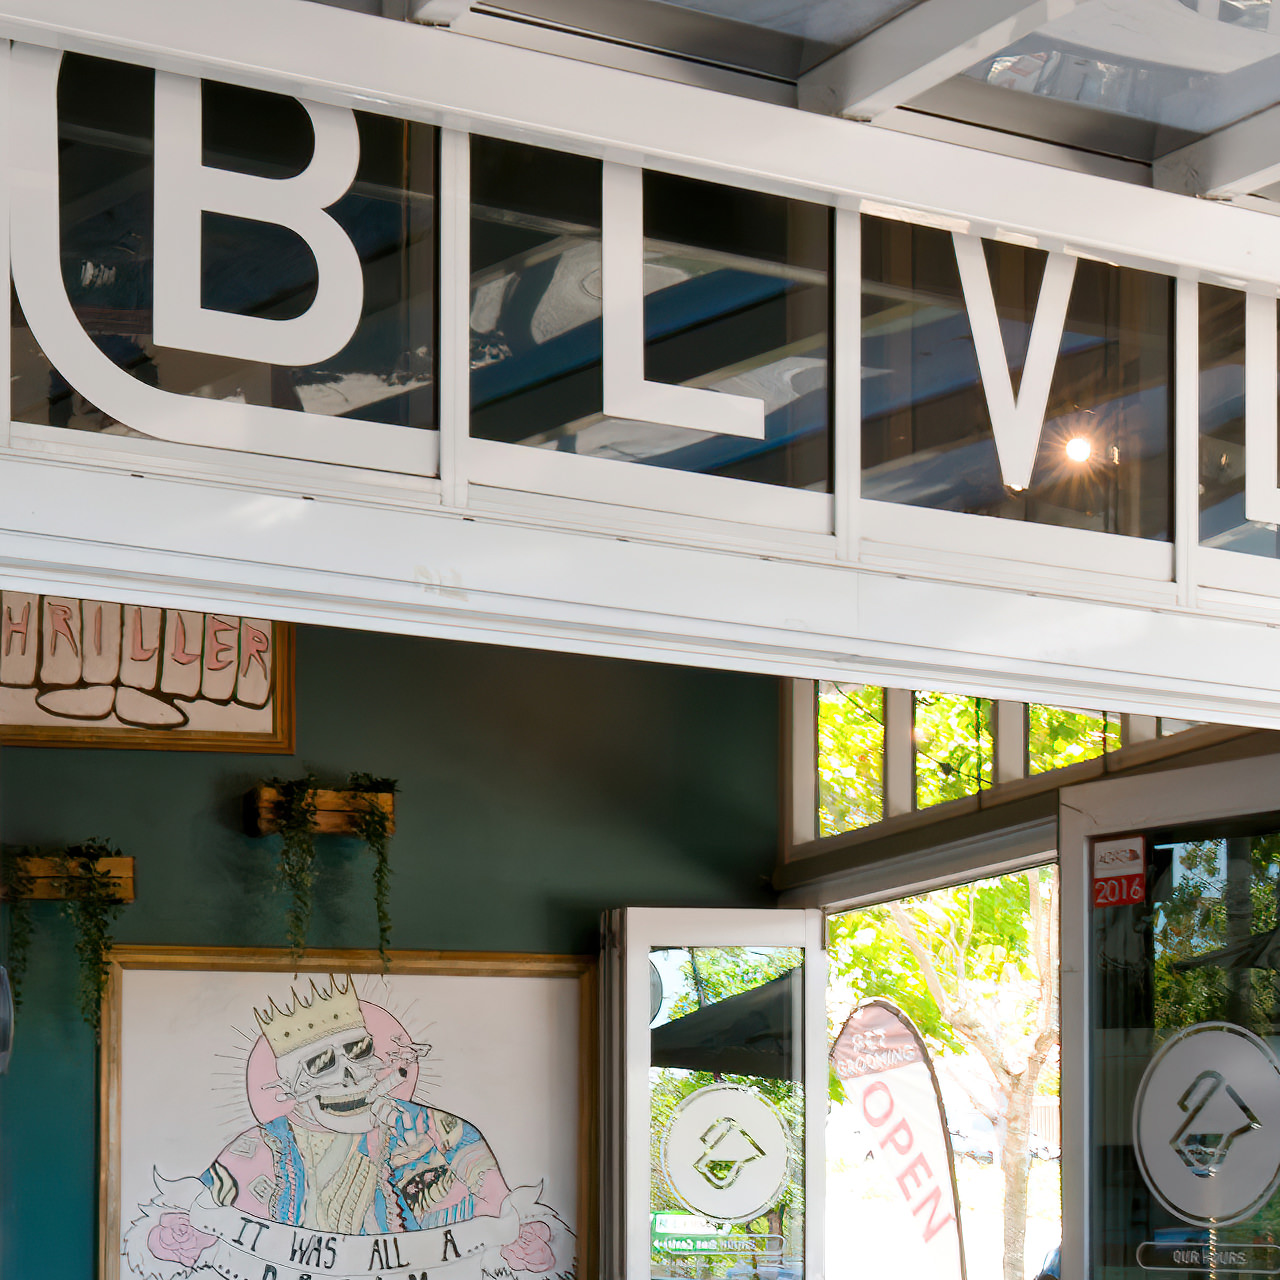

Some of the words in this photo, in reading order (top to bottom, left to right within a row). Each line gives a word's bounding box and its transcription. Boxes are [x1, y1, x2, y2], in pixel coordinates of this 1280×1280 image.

[1095, 878, 1142, 903] 2016
[862, 1081, 956, 1243] OPEN
[289, 1230, 338, 1269] WAS
[368, 1237, 410, 1271] ALL
[1173, 1249, 1200, 1265] OUR
